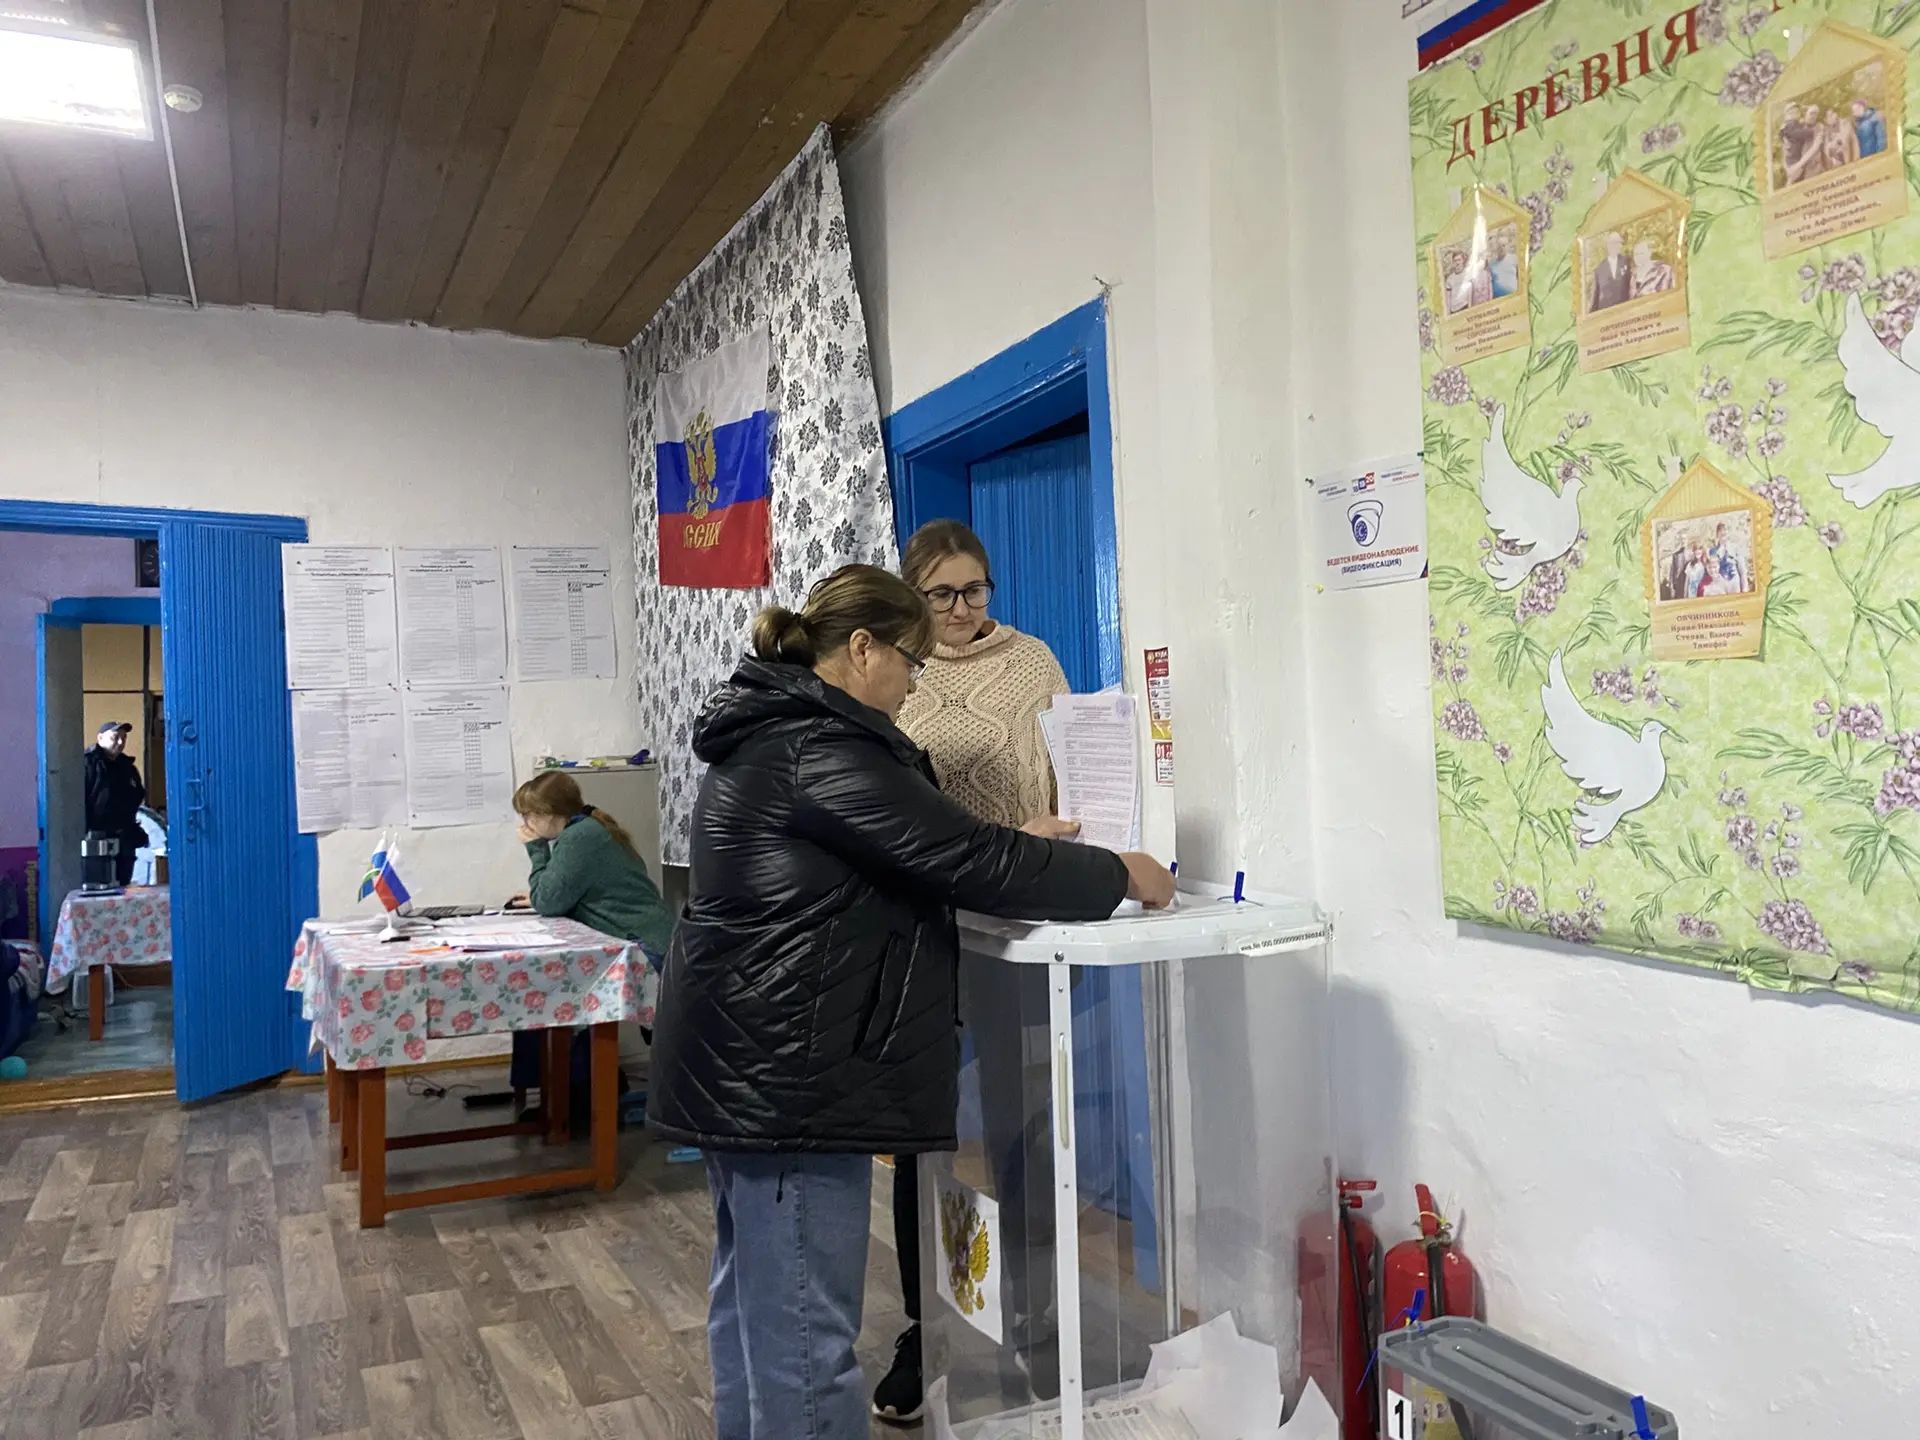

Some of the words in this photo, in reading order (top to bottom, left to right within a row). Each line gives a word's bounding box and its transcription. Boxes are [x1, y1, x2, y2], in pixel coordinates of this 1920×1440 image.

[1445, 4, 1703, 173] ДЕРЕВНЯ
[1327, 555, 1351, 567] ВЕДЕТСЯ
[1351, 545, 1420, 563] ВИДЕОНАБЛЮДЕНИЕ
[1341, 558, 1402, 575] (ВИДЕОФИКСАЦИЯ)
[1676, 610, 1740, 622] ОВЧИННИКОВА
[1394, 1399, 1404, 1439] 1
